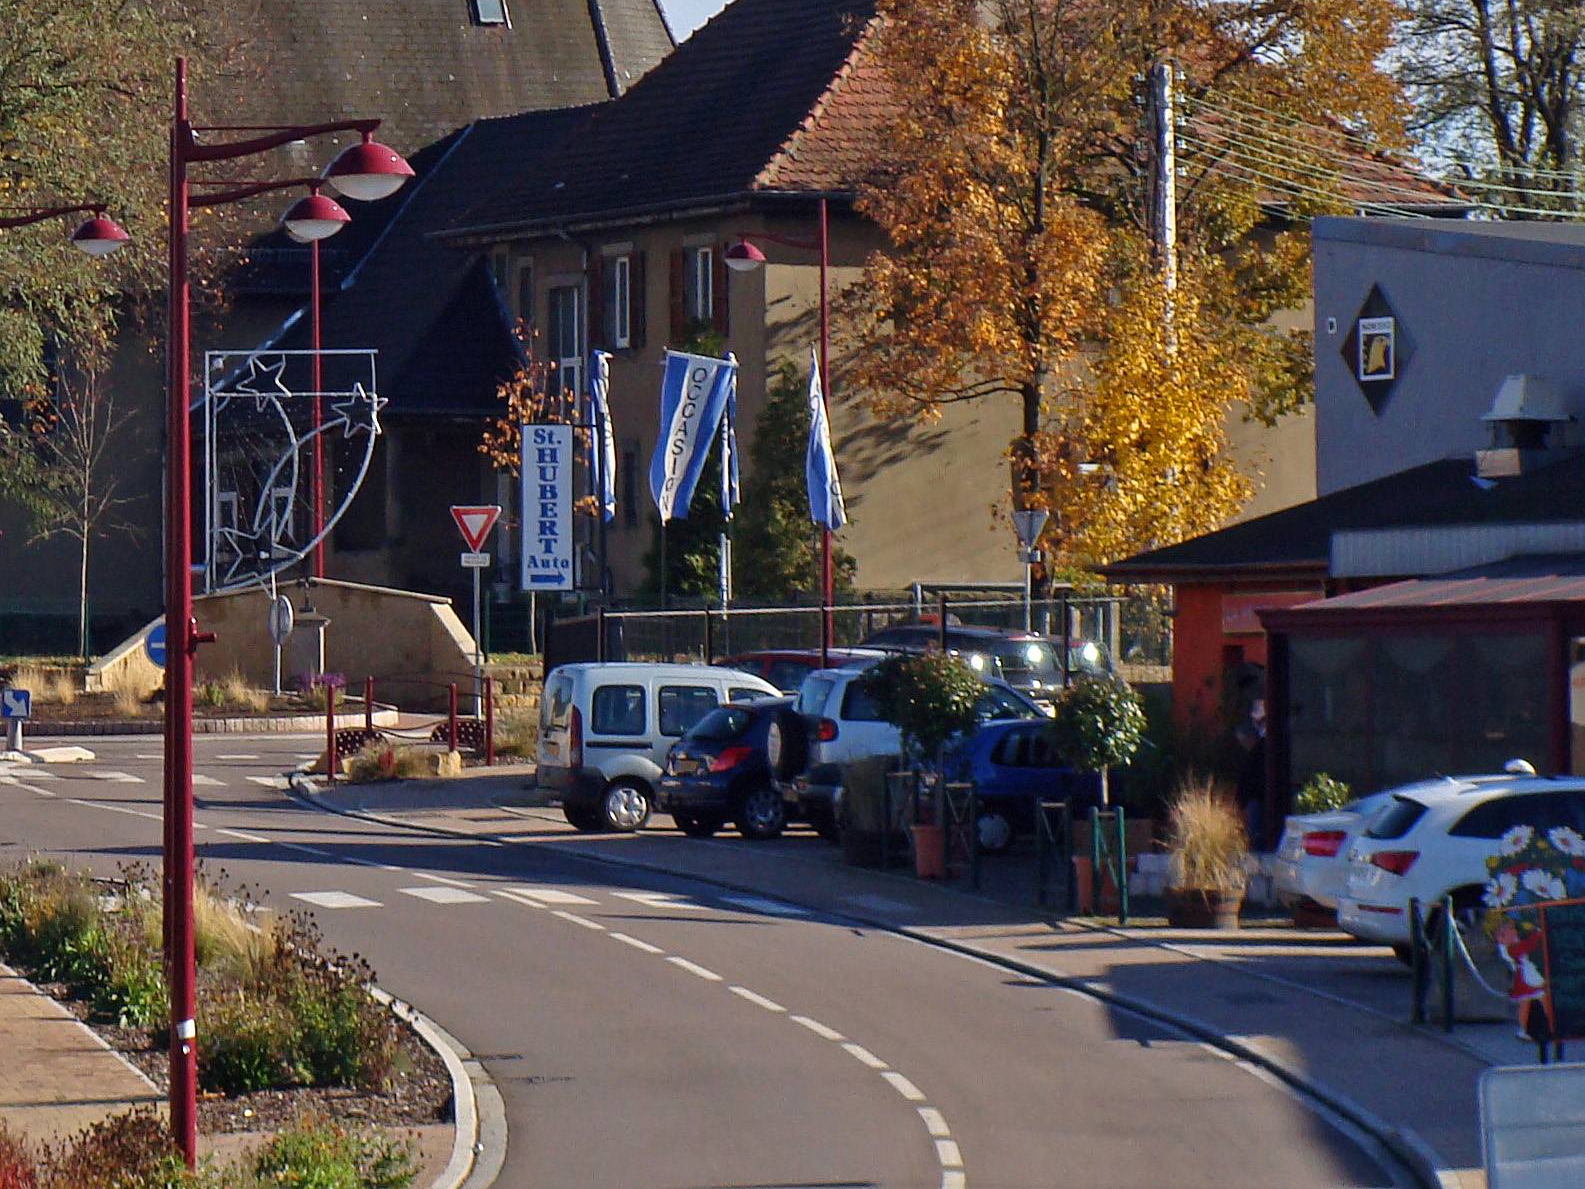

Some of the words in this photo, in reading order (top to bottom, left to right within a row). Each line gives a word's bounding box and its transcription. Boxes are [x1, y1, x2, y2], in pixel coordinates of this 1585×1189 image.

[533, 428, 562, 445] St.
[661, 367, 708, 512] OCCASION
[536, 447, 559, 554] HUBERT
[527, 555, 570, 570] Auto
